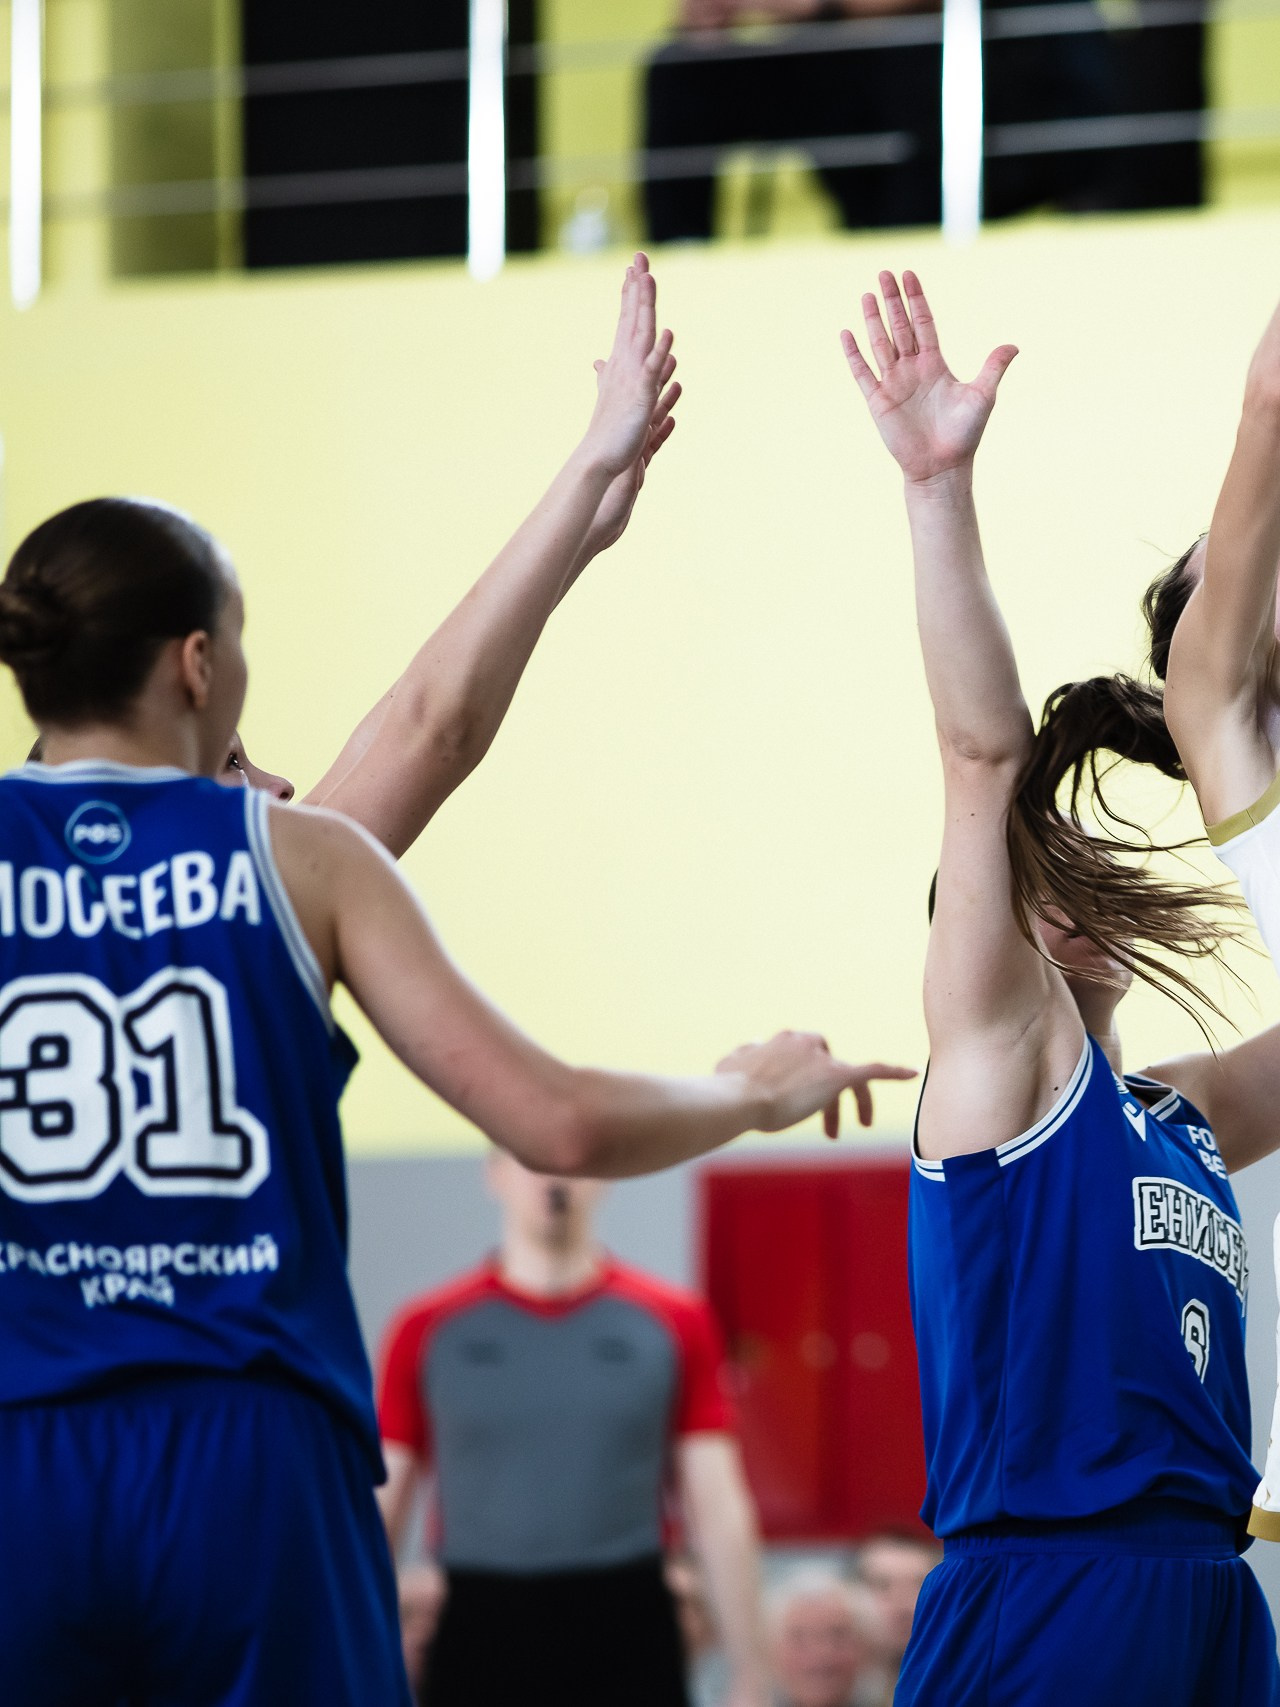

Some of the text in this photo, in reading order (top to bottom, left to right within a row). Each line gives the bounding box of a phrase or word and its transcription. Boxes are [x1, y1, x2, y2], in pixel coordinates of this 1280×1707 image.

[0, 965, 271, 1202] 31
[1186, 1124, 1219, 1153] FO
[1132, 1175, 1249, 1303] ЕНИСЕ
